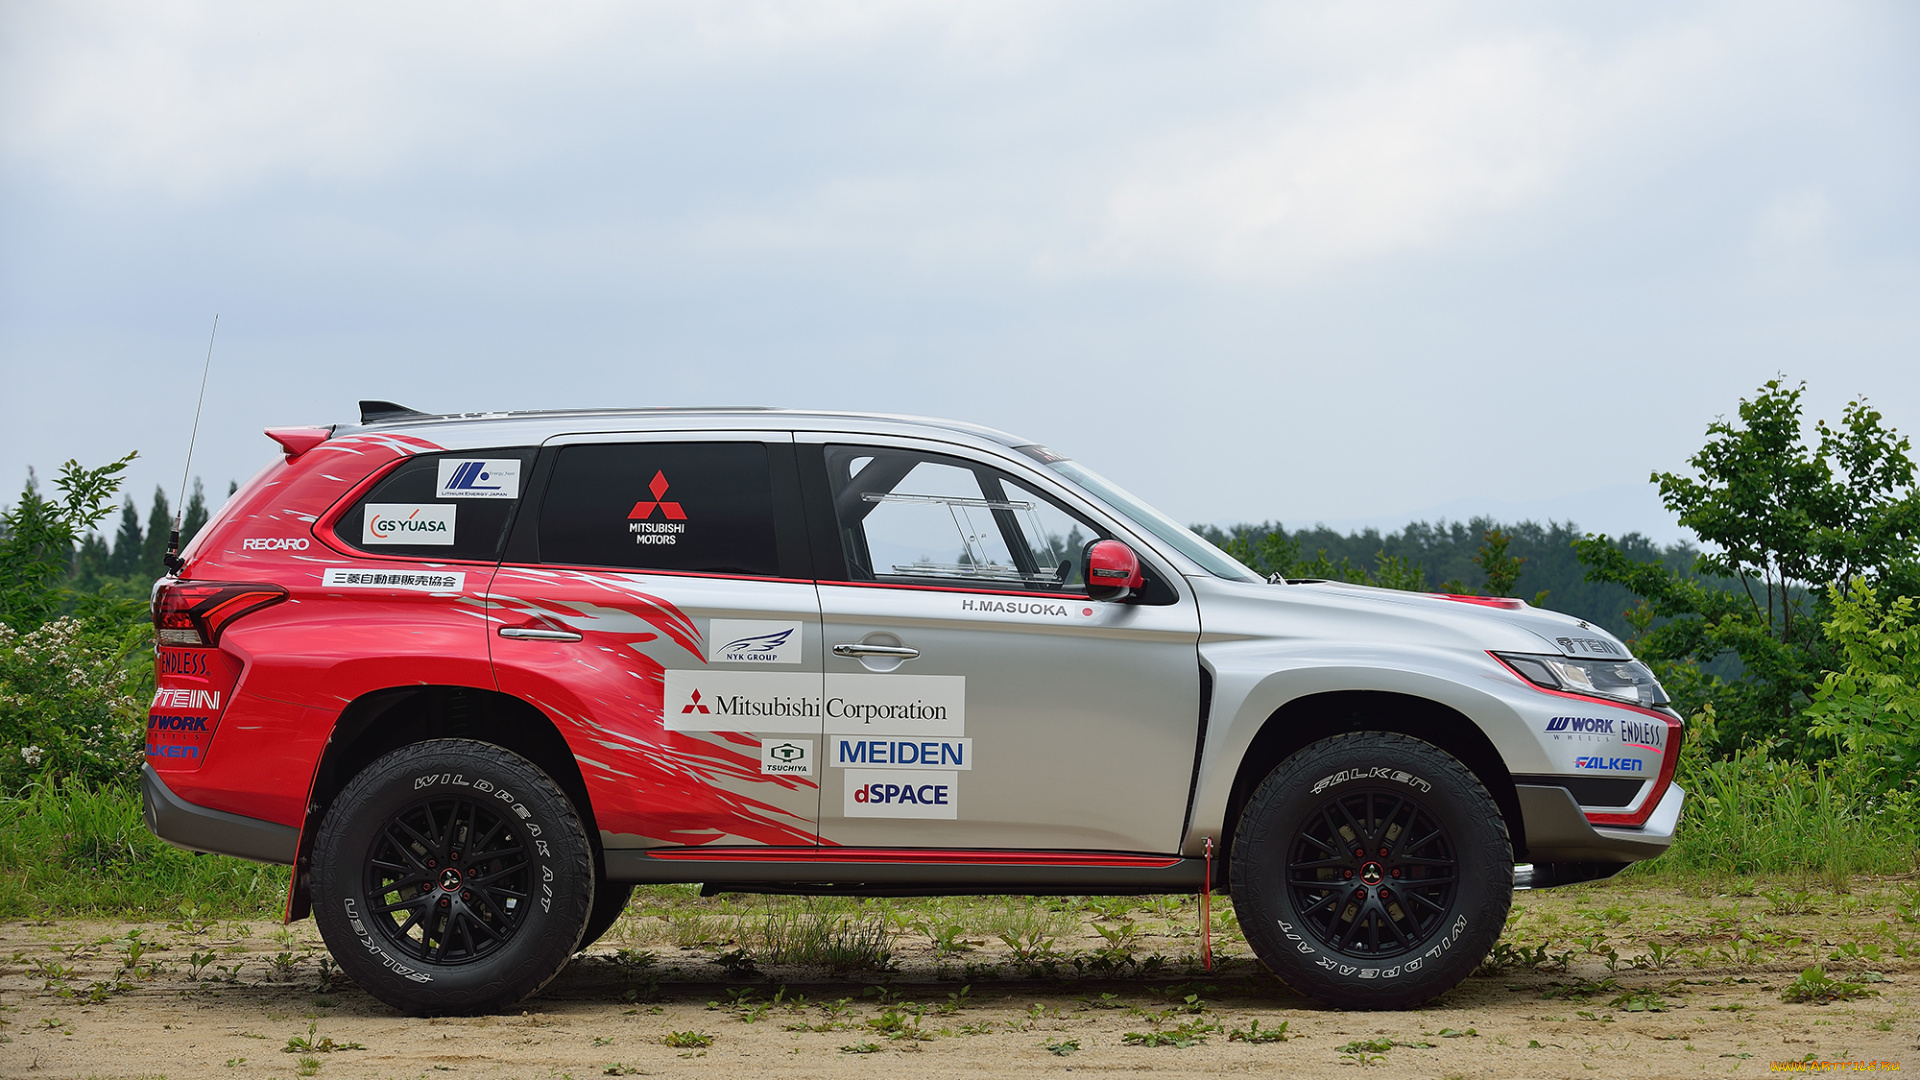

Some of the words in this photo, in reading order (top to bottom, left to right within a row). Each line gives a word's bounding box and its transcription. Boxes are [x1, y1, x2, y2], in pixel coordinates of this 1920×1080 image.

[377, 520, 396, 532] GS
[399, 520, 447, 532] YUASA
[629, 522, 685, 534] MITSUBISHI
[243, 538, 310, 550] RECARO
[636, 534, 677, 545] MOTORS
[333, 572, 456, 587] 三菱自動車販売協会
[962, 599, 1068, 617] H.MASUOKA
[1572, 637, 1621, 656] TEIN
[161, 652, 207, 675] ENDLESS
[727, 653, 744, 661] NYK
[161, 688, 221, 710] TEIN
[715, 695, 821, 718] Mitsubishi
[826, 697, 947, 725] Corporation
[1553, 734, 1610, 743] WHEELS
[1621, 720, 1660, 746] ENDLESS
[839, 740, 963, 766] MEIDEN
[766, 764, 807, 772] TSUCHIYA
[1574, 756, 1643, 772] FALKEN
[1310, 766, 1432, 794] FALKEN
[854, 784, 949, 805] dSPACE
[414, 773, 550, 858] WILDPEAK
[344, 898, 434, 984] FALKEN
[1315, 913, 1468, 979] WILDPEAK
